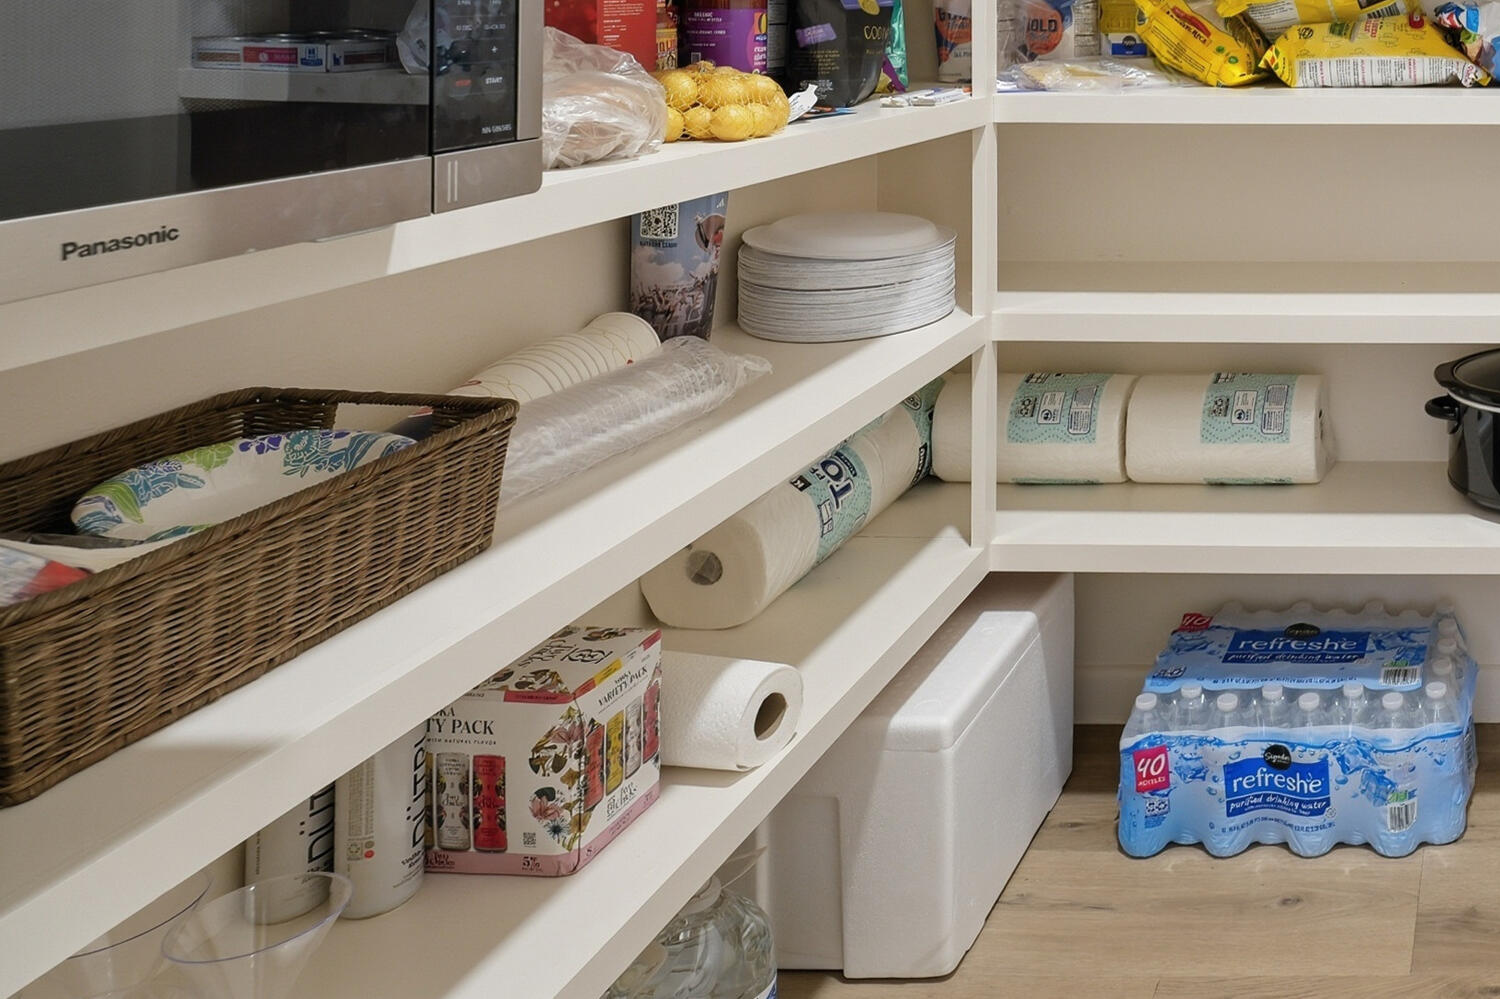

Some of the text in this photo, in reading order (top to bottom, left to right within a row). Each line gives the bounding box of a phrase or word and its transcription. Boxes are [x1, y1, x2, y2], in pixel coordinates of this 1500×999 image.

[60, 225, 180, 261] Panasonic
[1228, 653, 1272, 661] purified
[1275, 652, 1322, 661] drinking
[451, 719, 495, 735] PACK
[1136, 754, 1166, 779] 40
[1229, 793, 1327, 813] purified drinking water
